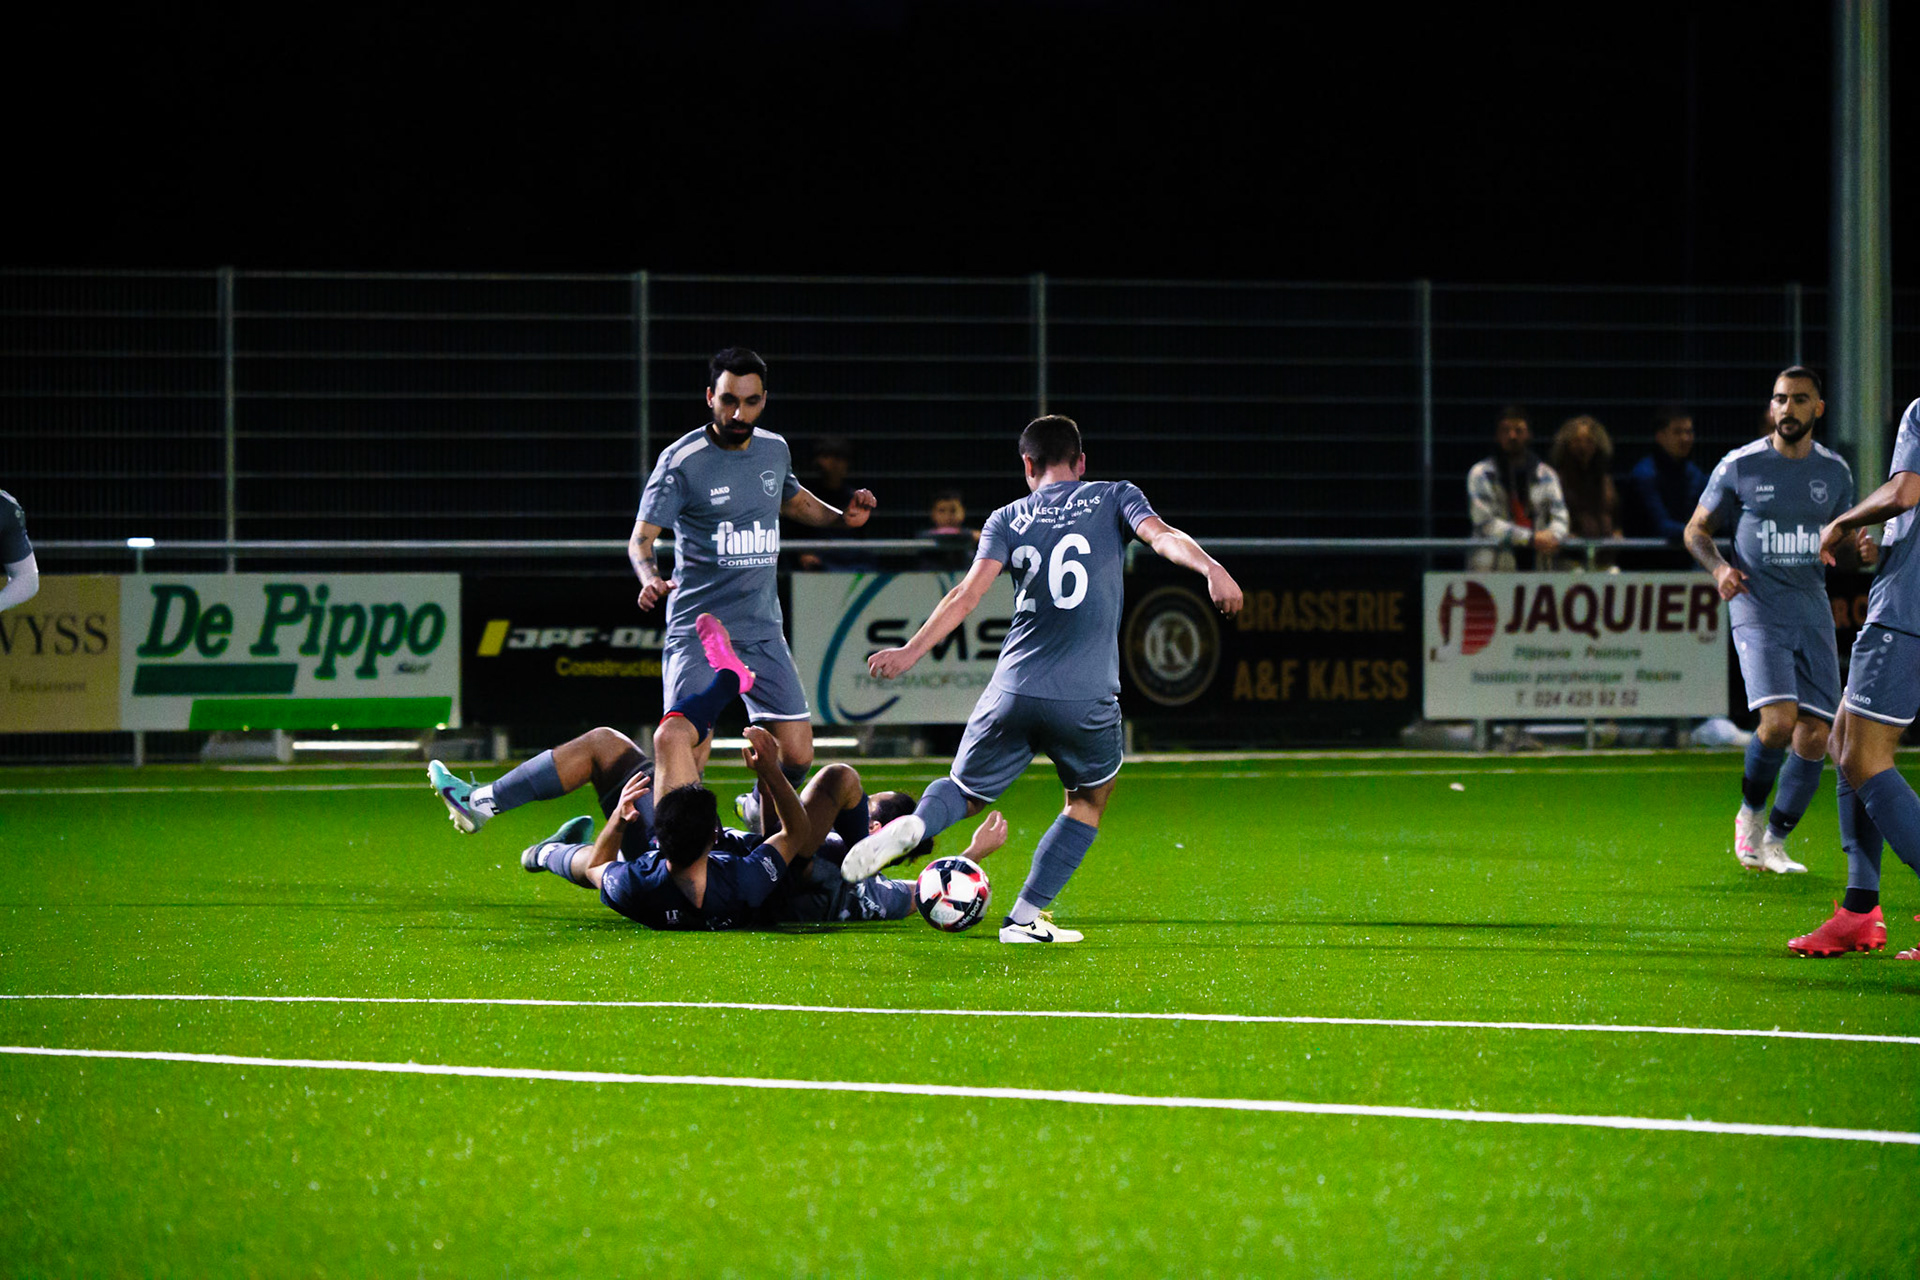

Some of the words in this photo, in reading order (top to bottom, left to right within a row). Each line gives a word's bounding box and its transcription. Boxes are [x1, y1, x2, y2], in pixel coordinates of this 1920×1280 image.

[710, 486, 730, 496] JAKO
[711, 520, 780, 556] fantol
[1756, 519, 1825, 554] fanto
[717, 556, 778, 567] Constructi
[1011, 533, 1092, 611] 26
[1762, 555, 1820, 564] Construct
[1236, 590, 1404, 632] BRASSERIE
[1505, 583, 1721, 640] JAQUIER
[137, 584, 233, 657] De
[250, 584, 446, 679] Pippo
[507, 627, 663, 649] JPF-DU
[555, 657, 662, 677] Constructio
[1233, 660, 1299, 700] A&F
[1307, 660, 1410, 700] KAESS
